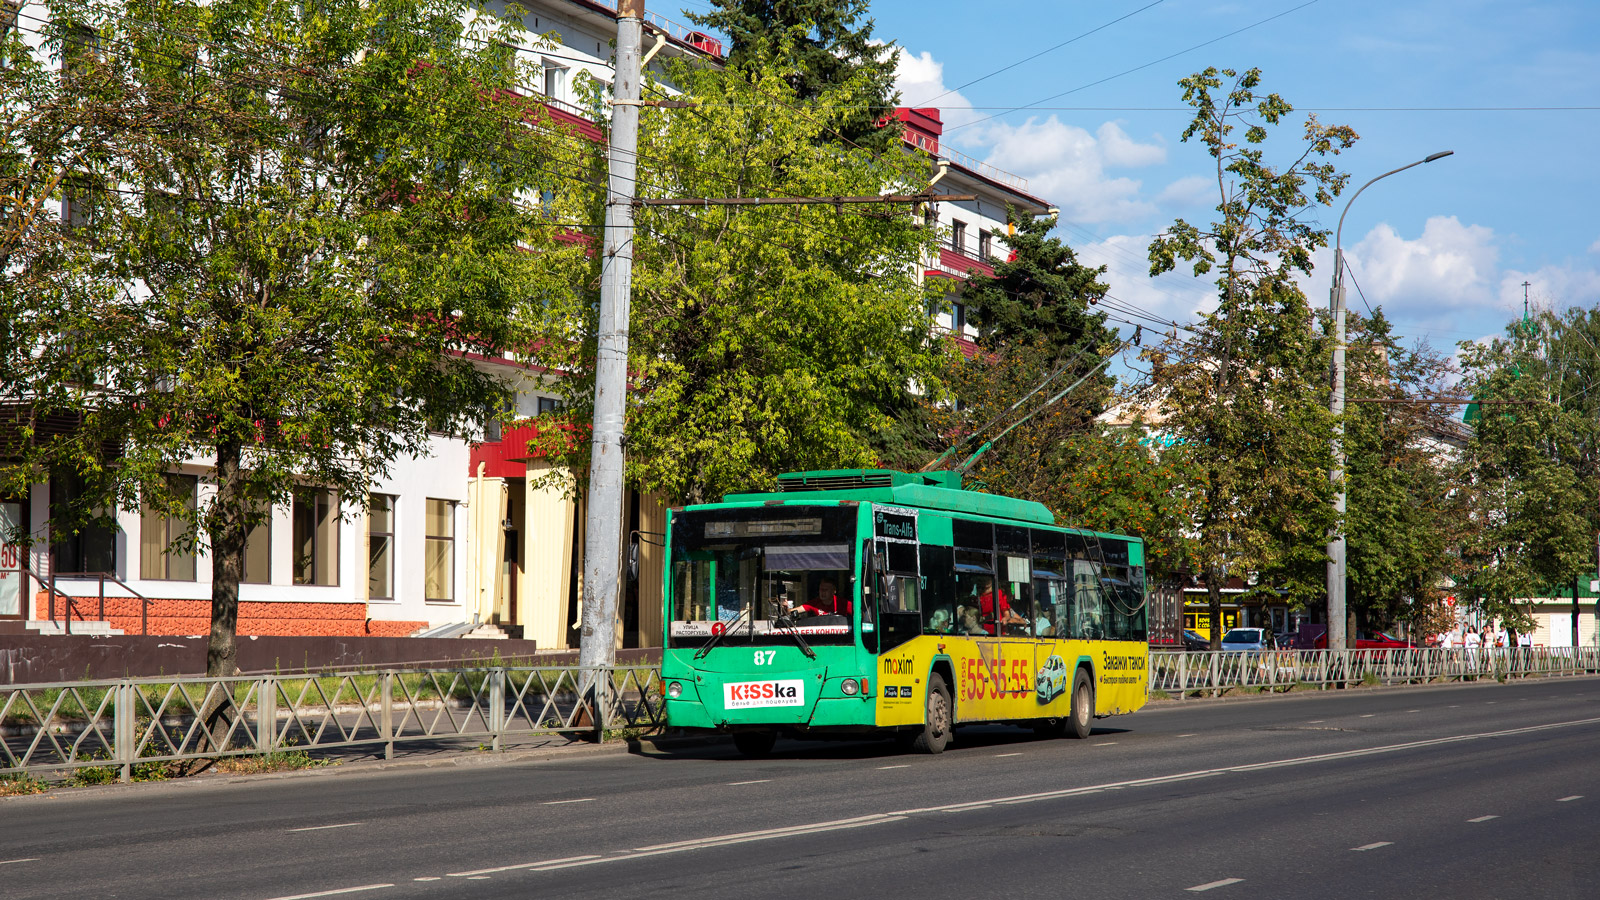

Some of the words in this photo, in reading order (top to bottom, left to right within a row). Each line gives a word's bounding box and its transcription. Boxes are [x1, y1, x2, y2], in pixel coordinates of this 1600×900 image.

[883, 519, 913, 538] Trans-Alfa
[715, 623, 722, 635] 1
[754, 650, 776, 665] 87
[884, 653, 914, 674] maxim
[1103, 650, 1127, 670] Закажи
[1128, 656, 1146, 670] такси
